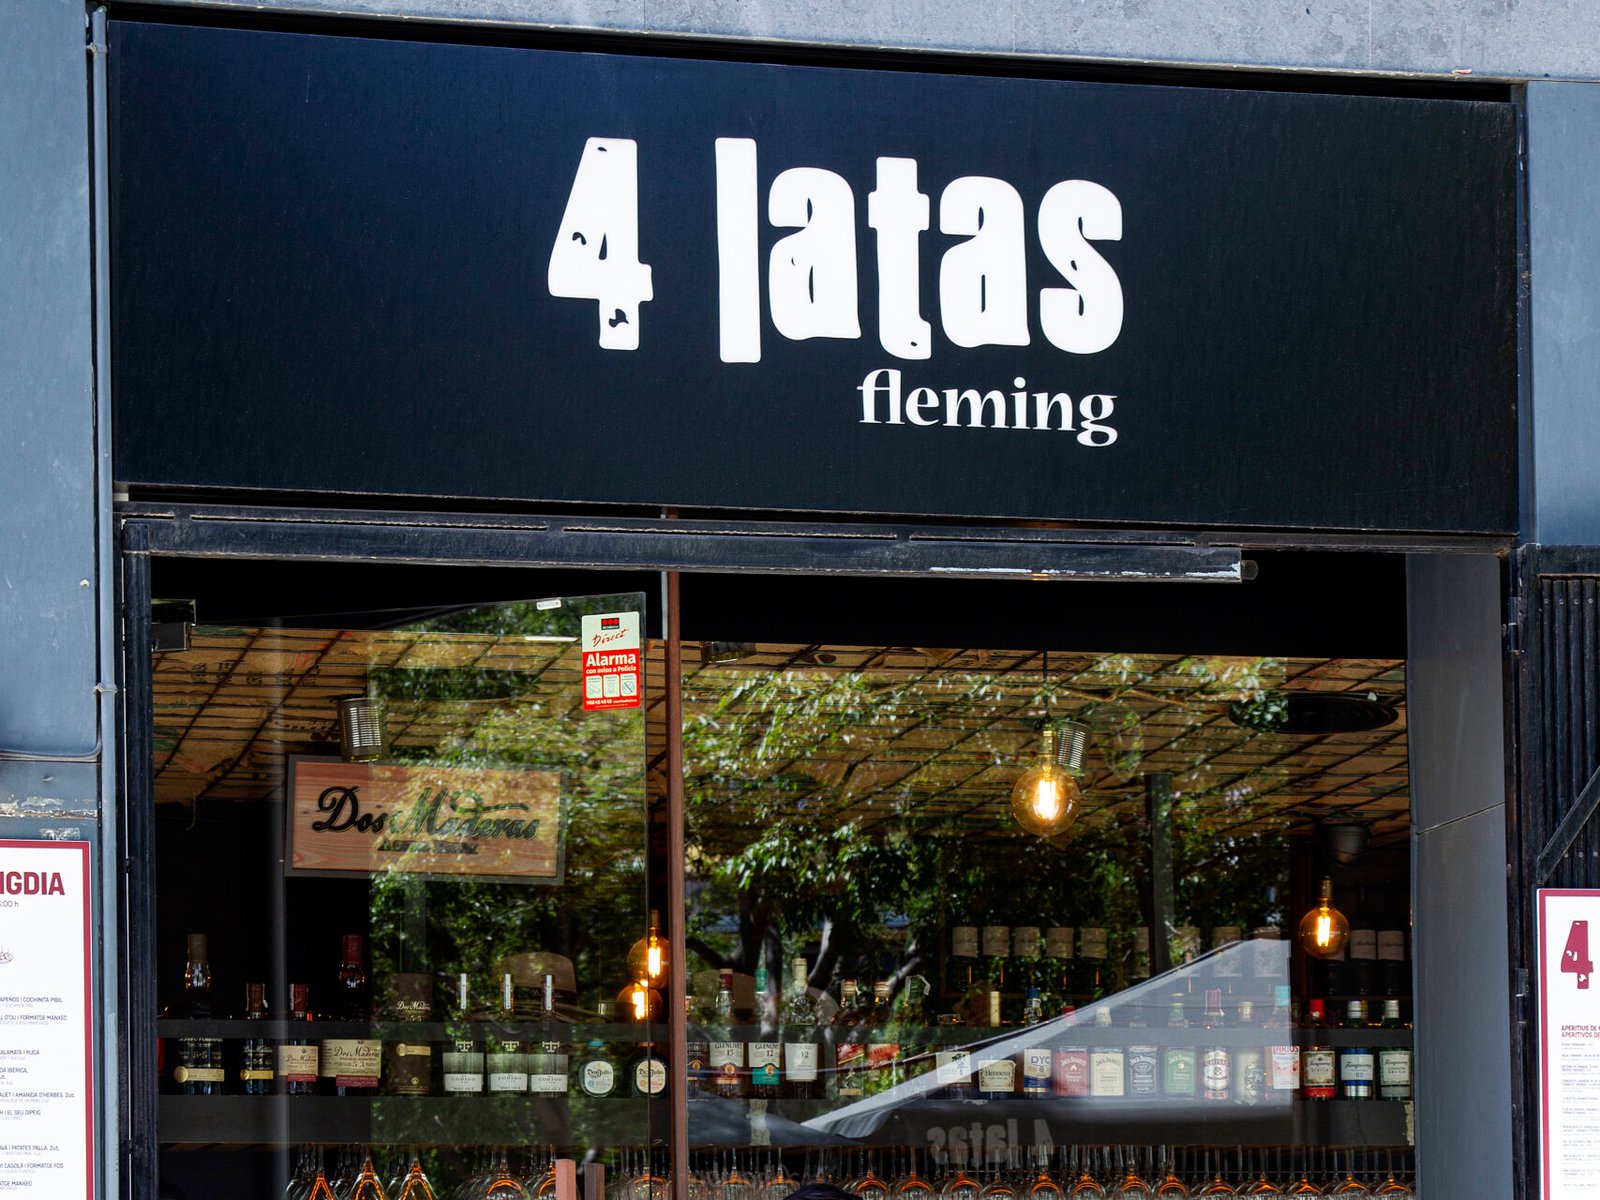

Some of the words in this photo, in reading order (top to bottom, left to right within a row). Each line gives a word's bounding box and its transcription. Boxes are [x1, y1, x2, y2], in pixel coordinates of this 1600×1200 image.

[547, 136, 654, 350] 4
[714, 136, 1124, 364] latas
[856, 368, 1118, 447] fleming
[586, 652, 636, 667] Alarma
[312, 785, 388, 834] Dos
[389, 786, 541, 840] Maderas
[1560, 920, 1594, 990] 4
